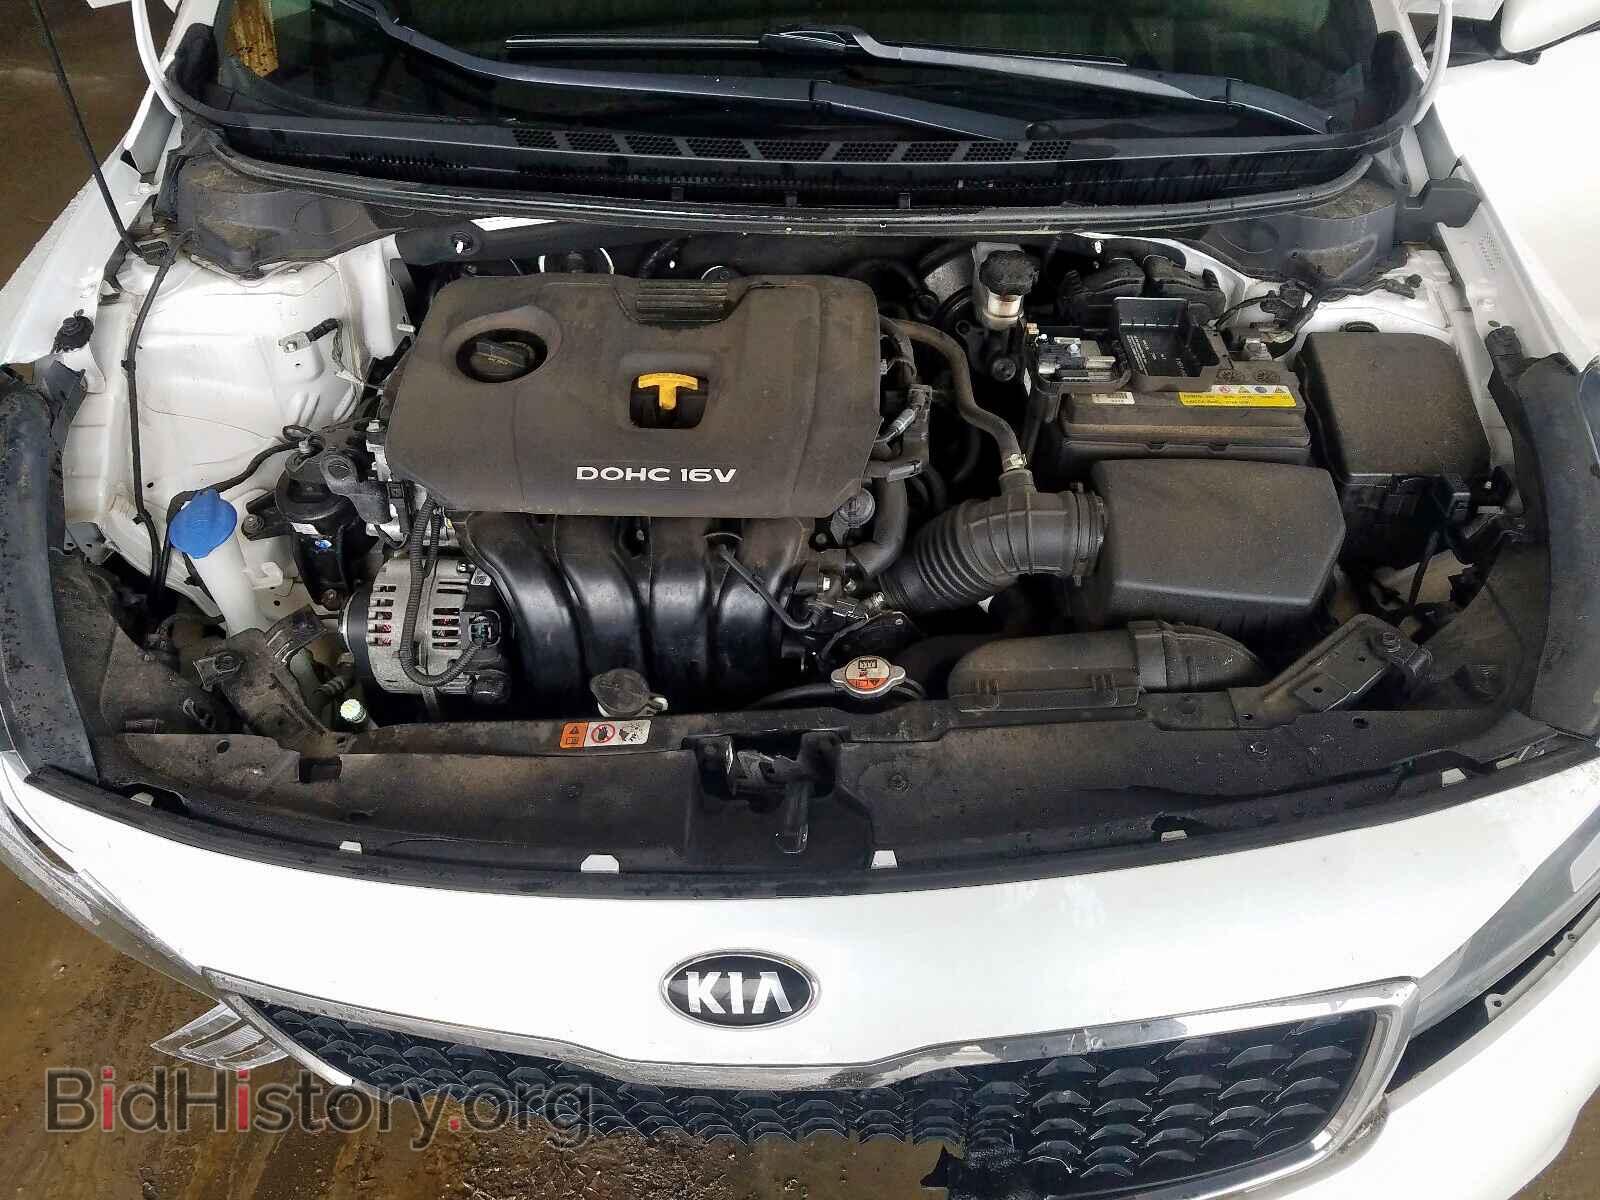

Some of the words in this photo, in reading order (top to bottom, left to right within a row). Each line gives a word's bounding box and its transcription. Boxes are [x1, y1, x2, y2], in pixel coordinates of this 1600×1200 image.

[576, 466, 671, 482] DOHC
[680, 467, 737, 483] 16V
[686, 971, 793, 1014] KIA
